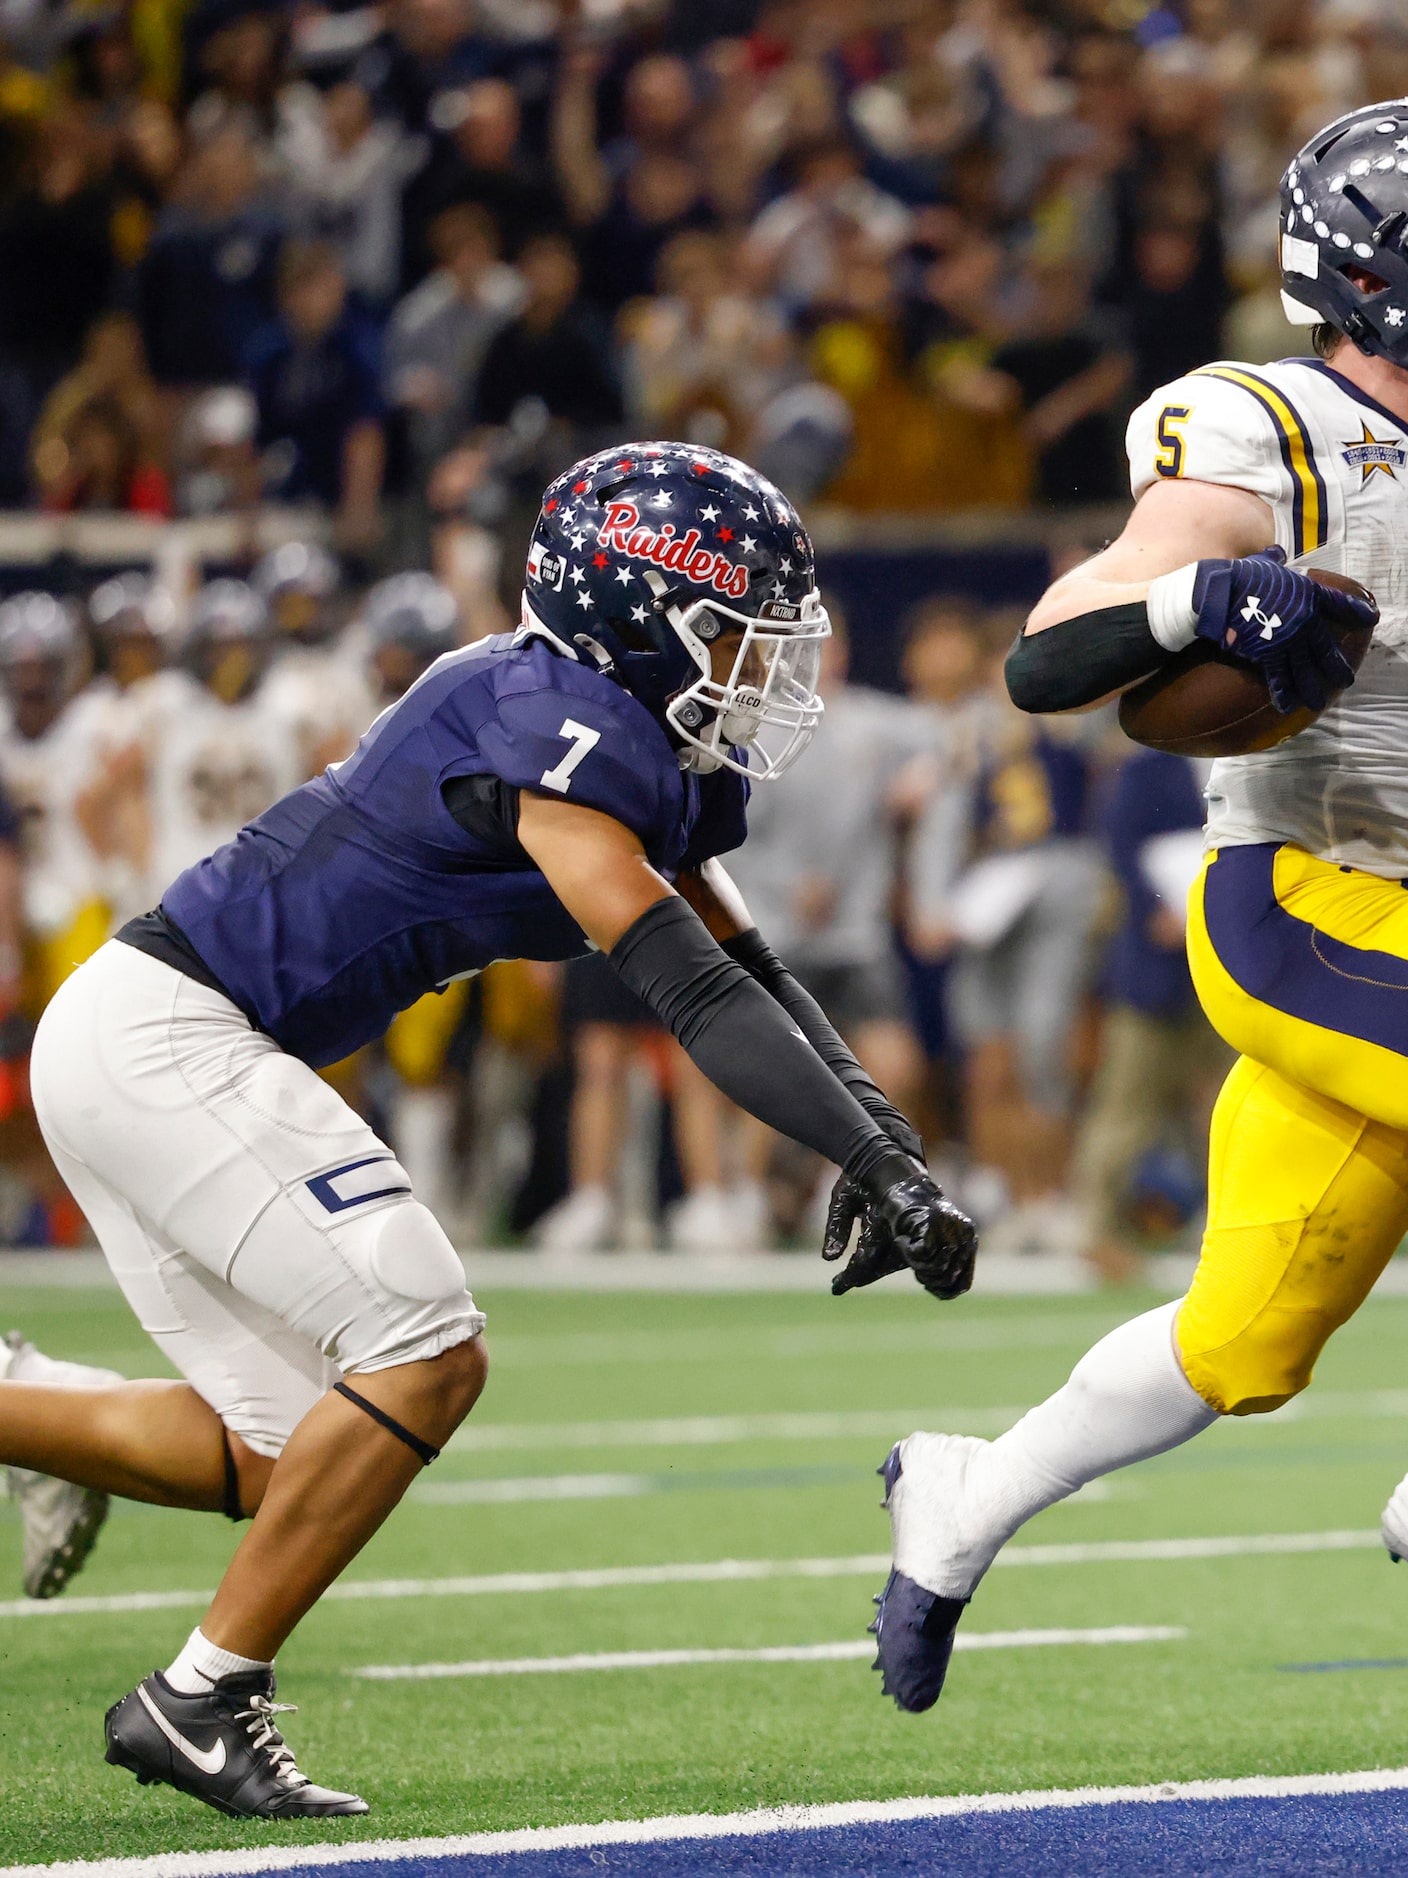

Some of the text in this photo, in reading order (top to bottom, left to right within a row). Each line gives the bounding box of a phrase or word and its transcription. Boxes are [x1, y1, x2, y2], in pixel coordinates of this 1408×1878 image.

[1154, 404, 1196, 480] 5
[597, 501, 750, 599] Raiders
[735, 692, 761, 708] LLCD
[540, 718, 602, 794] 7
